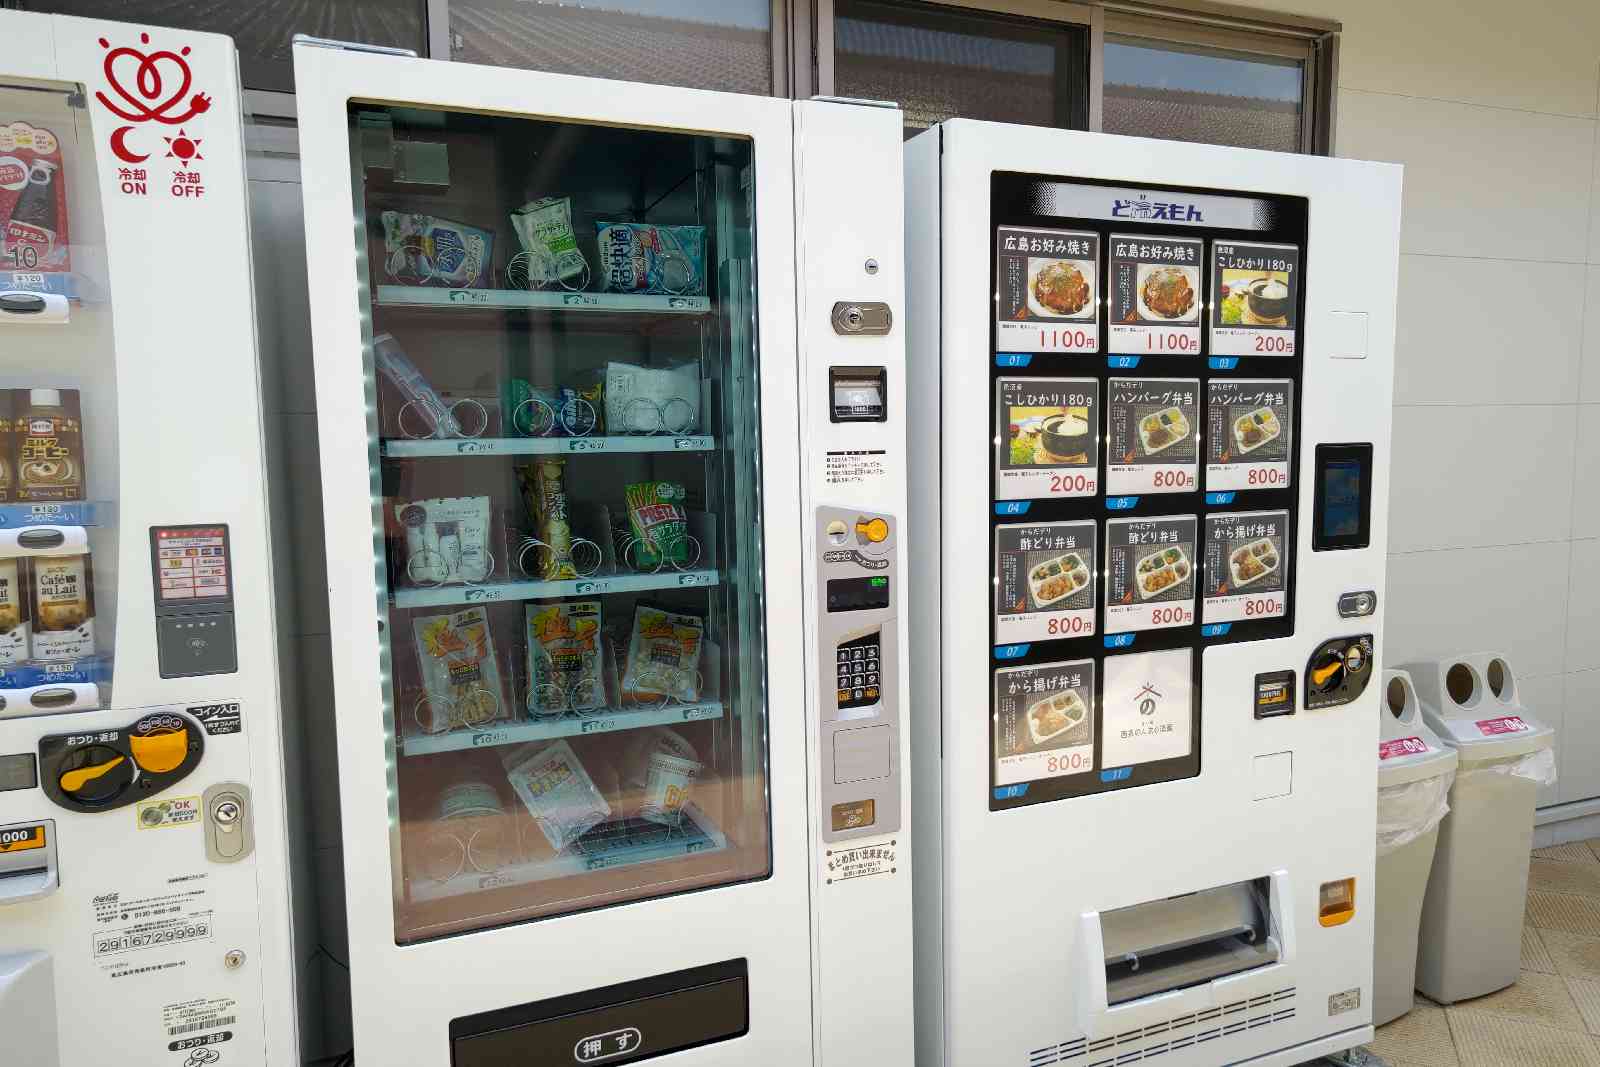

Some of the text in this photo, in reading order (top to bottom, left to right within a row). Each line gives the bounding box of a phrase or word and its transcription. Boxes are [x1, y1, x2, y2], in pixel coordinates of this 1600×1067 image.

[118, 168, 147, 182] 冷却
[173, 171, 200, 184] 冷却
[121, 182, 147, 196] ON
[171, 185, 205, 198] OFF
[1004, 235, 1091, 255] 広島お好み焼き
[1115, 242, 1195, 261] 広島お好み焼き
[1218, 256, 1293, 273] こしひかり180g
[1040, 331, 1095, 349] 1100円
[1147, 333, 1199, 351] 1100円
[1255, 336, 1293, 353] 200円
[1009, 355, 1020, 366] 01
[1119, 357, 1130, 367] 02
[1219, 358, 1230, 368] 03
[1005, 393, 1093, 407] こしひかり180g
[1113, 392, 1194, 405] ハンバーグ弁当
[1210, 393, 1284, 406] ハンバーグ弁当
[1051, 475, 1095, 492] 200円
[1154, 470, 1194, 487] 800円
[1248, 468, 1286, 485] 800円
[1215, 493, 1226, 503] 06
[1128, 531, 1179, 544] 酢どり弁当
[1214, 524, 1276, 539] から揚げ弁当
[1020, 536, 1076, 550] 酢どり弁当
[1245, 598, 1283, 616] 800円
[1151, 607, 1192, 625] 800円
[1047, 616, 1092, 635] 800円
[1006, 647, 1018, 657] 07
[1008, 674, 1082, 694] から揚げ弁当
[194, 703, 239, 716] コイン入口
[1047, 753, 1090, 773] 800円
[174, 799, 191, 810] OK
[0, 830, 28, 843] 000
[827, 848, 896, 872] まとめ買い出来ません
[582, 1032, 633, 1059] 押す
